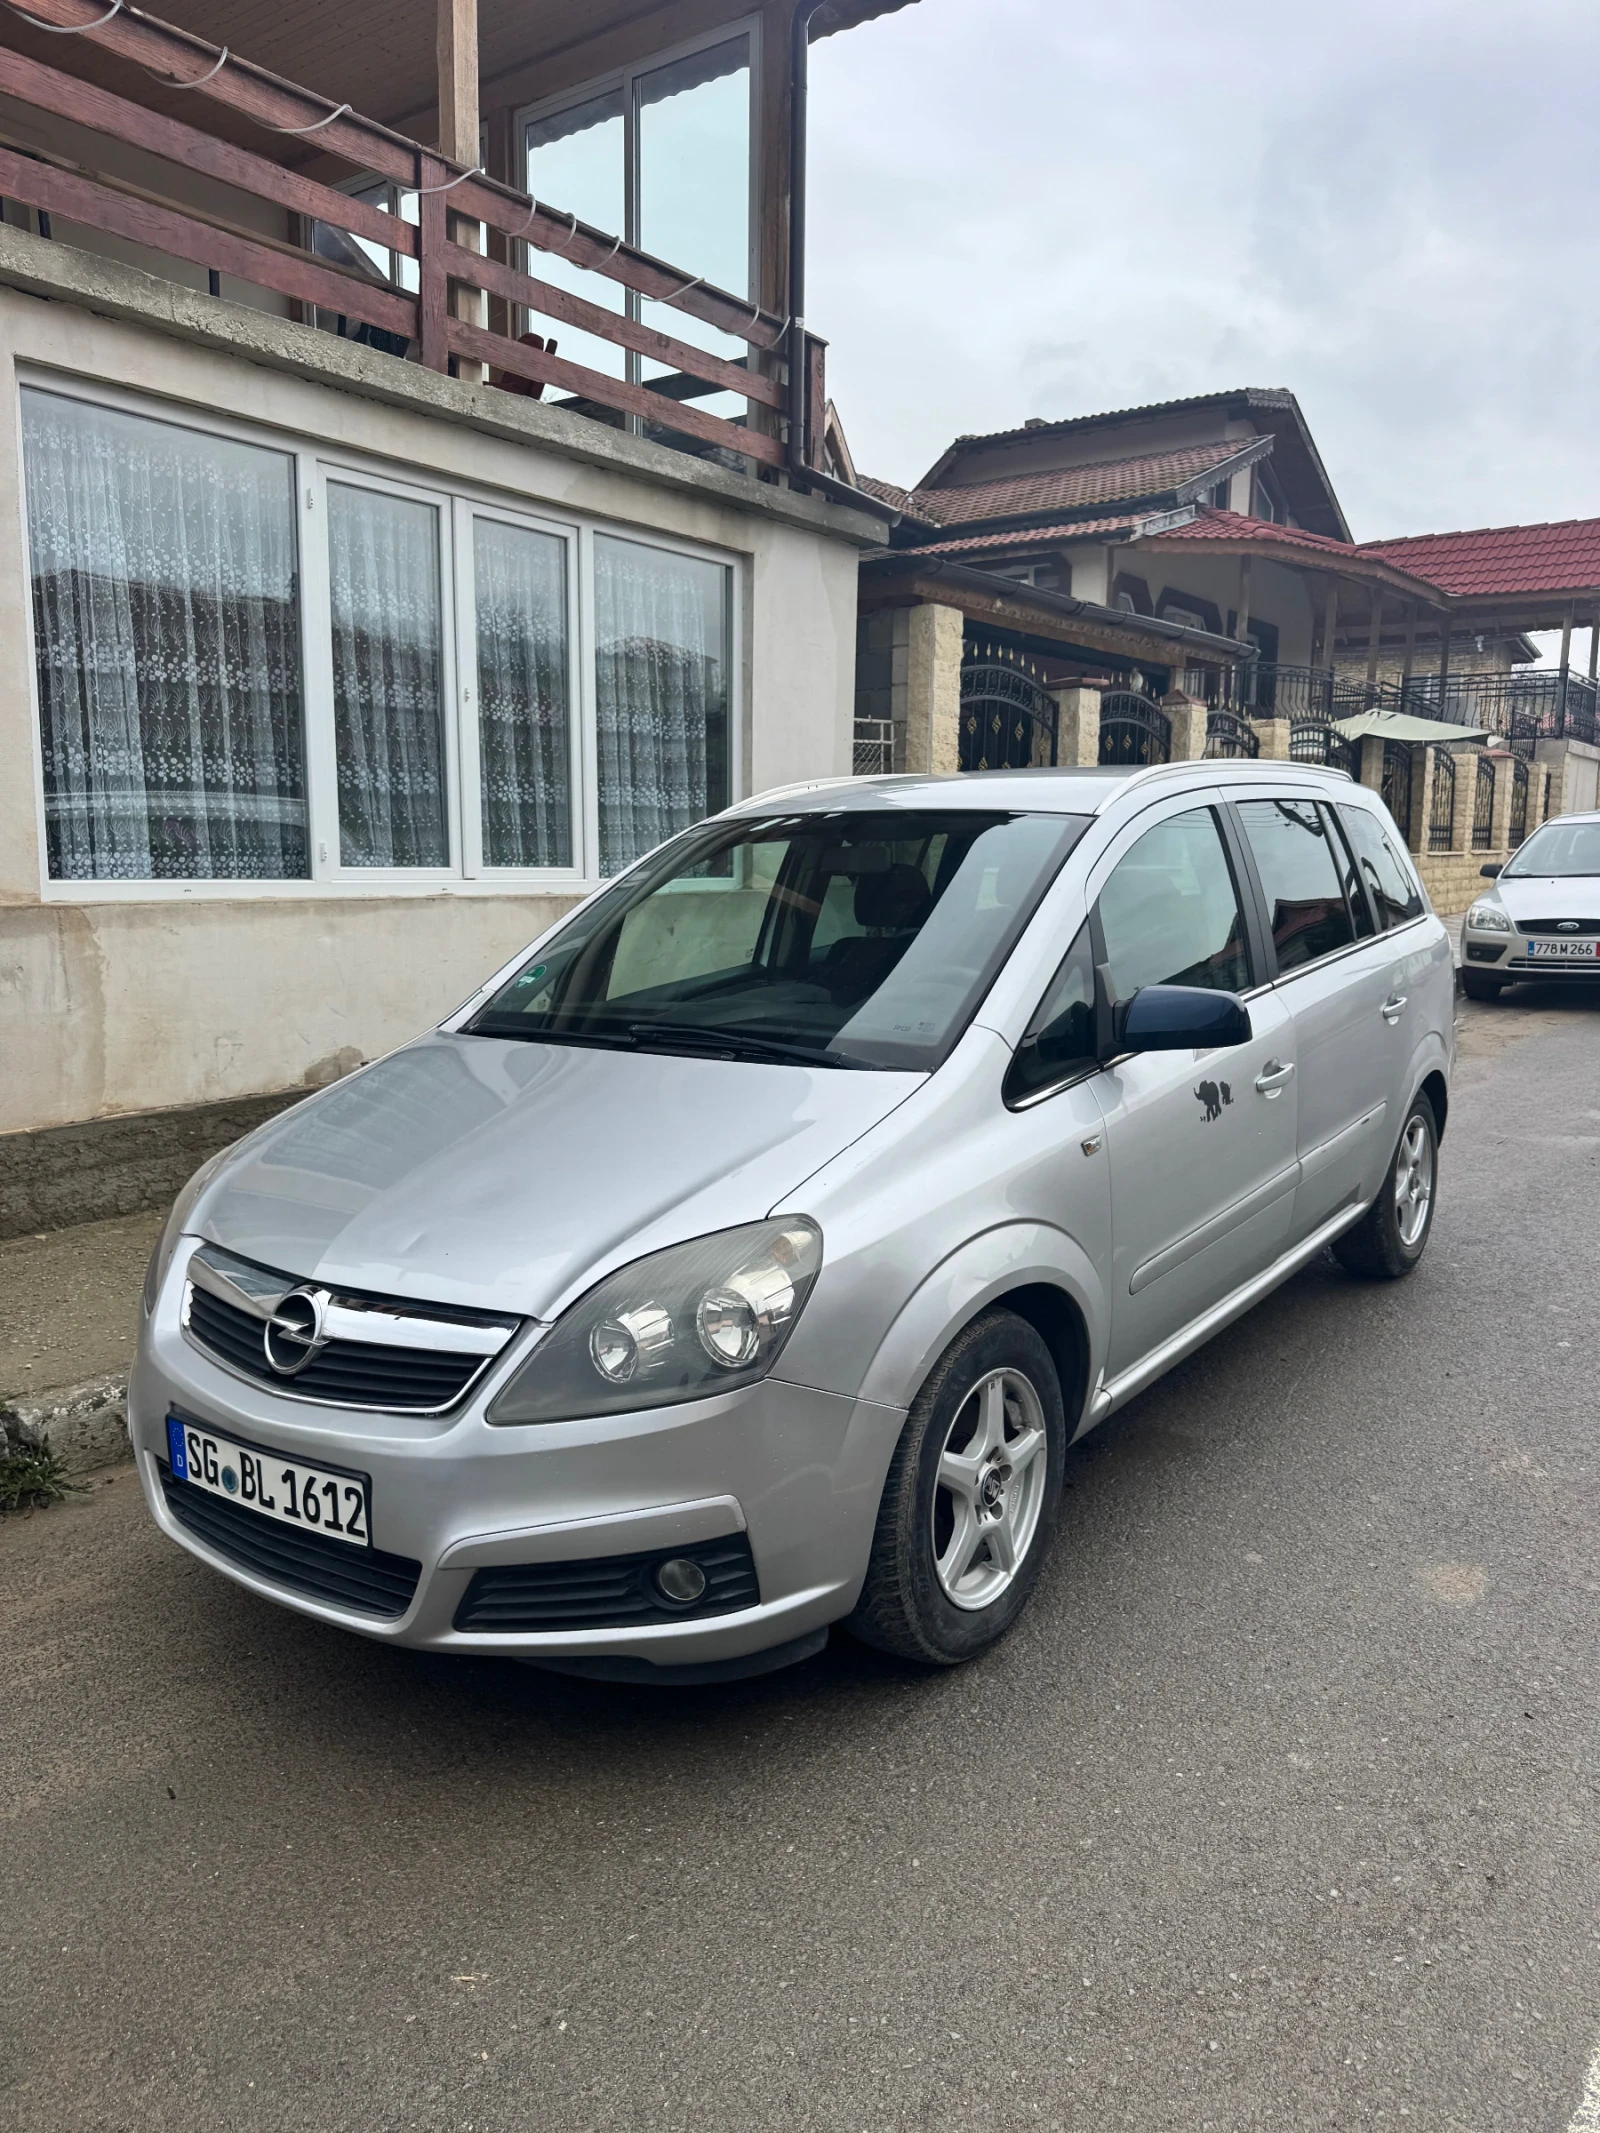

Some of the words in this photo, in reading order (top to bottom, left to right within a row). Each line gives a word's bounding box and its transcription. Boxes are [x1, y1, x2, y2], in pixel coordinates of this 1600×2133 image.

[1536, 943, 1558, 955] 778
[1560, 943, 1568, 955] M
[1570, 943, 1593, 955] 266
[176, 1453, 184, 1467] D
[187, 1432, 219, 1487] SG
[239, 1452, 275, 1510] BL
[281, 1468, 366, 1539] 1612
